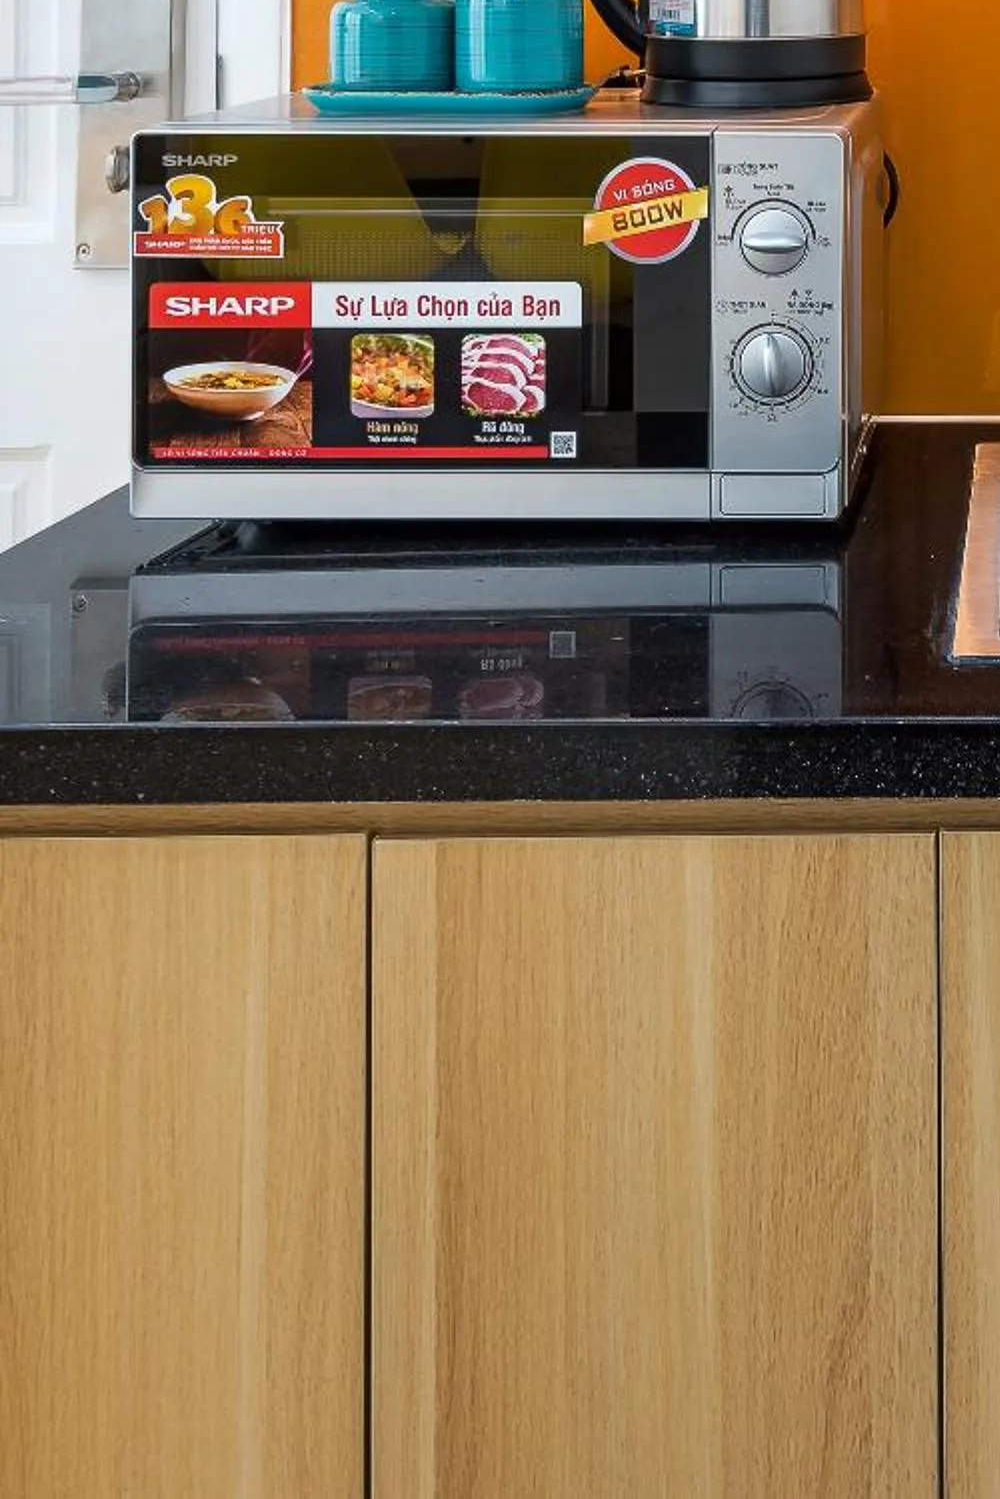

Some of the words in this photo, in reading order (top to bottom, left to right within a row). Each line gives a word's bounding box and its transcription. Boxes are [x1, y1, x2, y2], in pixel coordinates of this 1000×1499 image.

[161, 154, 239, 168] SHARP
[139, 174, 253, 235] 136
[613, 189, 628, 202] VI
[611, 199, 684, 233] 800W
[165, 296, 296, 317] SHARP
[335, 295, 365, 320] Sự
[371, 295, 408, 320] Lựa
[416, 295, 469, 320] Chọn
[477, 289, 513, 317] của
[522, 295, 561, 320] Bạn
